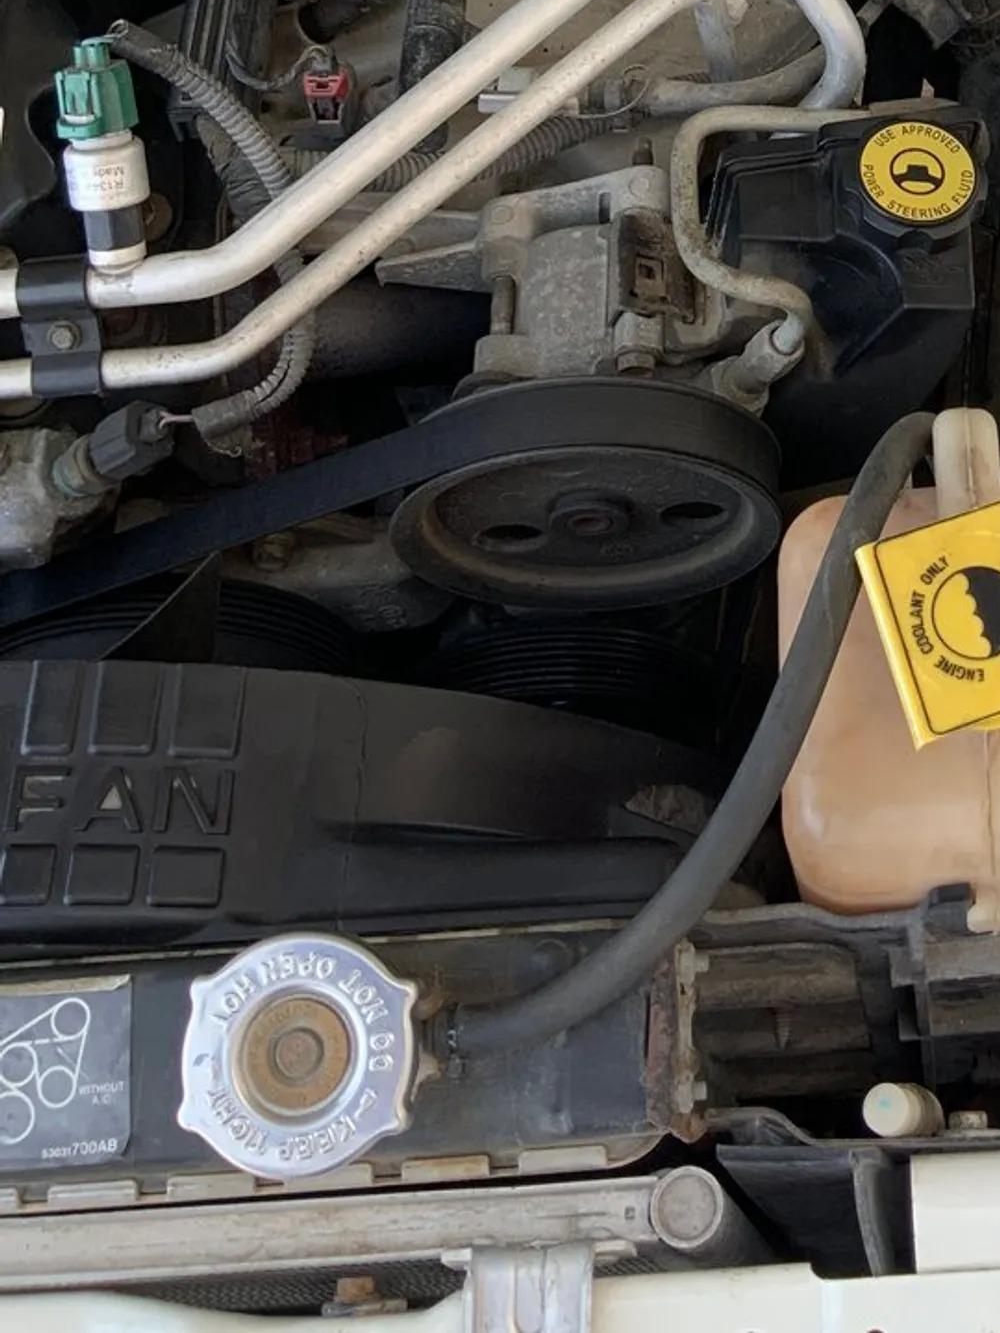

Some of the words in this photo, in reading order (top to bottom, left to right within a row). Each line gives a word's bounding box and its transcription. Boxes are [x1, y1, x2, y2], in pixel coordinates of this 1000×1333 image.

[874, 129, 896, 147] USE
[902, 125, 961, 154] APPROVED
[863, 164, 885, 199] POWER
[887, 199, 952, 218] STEERING
[951, 170, 974, 206] FLUID
[920, 555, 950, 586] ONLY
[909, 589, 935, 655] COOLANT
[934, 654, 985, 683] ENGINE
[2, 765, 236, 835] FAN
[257, 951, 338, 984] OPEN
[210, 975, 257, 1025] HOT
[338, 969, 389, 1024] NOT
[369, 1032, 394, 1071] DO
[78, 1081, 125, 1095] WITHOUT
[207, 1086, 269, 1156] TIGHT
[278, 1115, 358, 1160] KEEP
